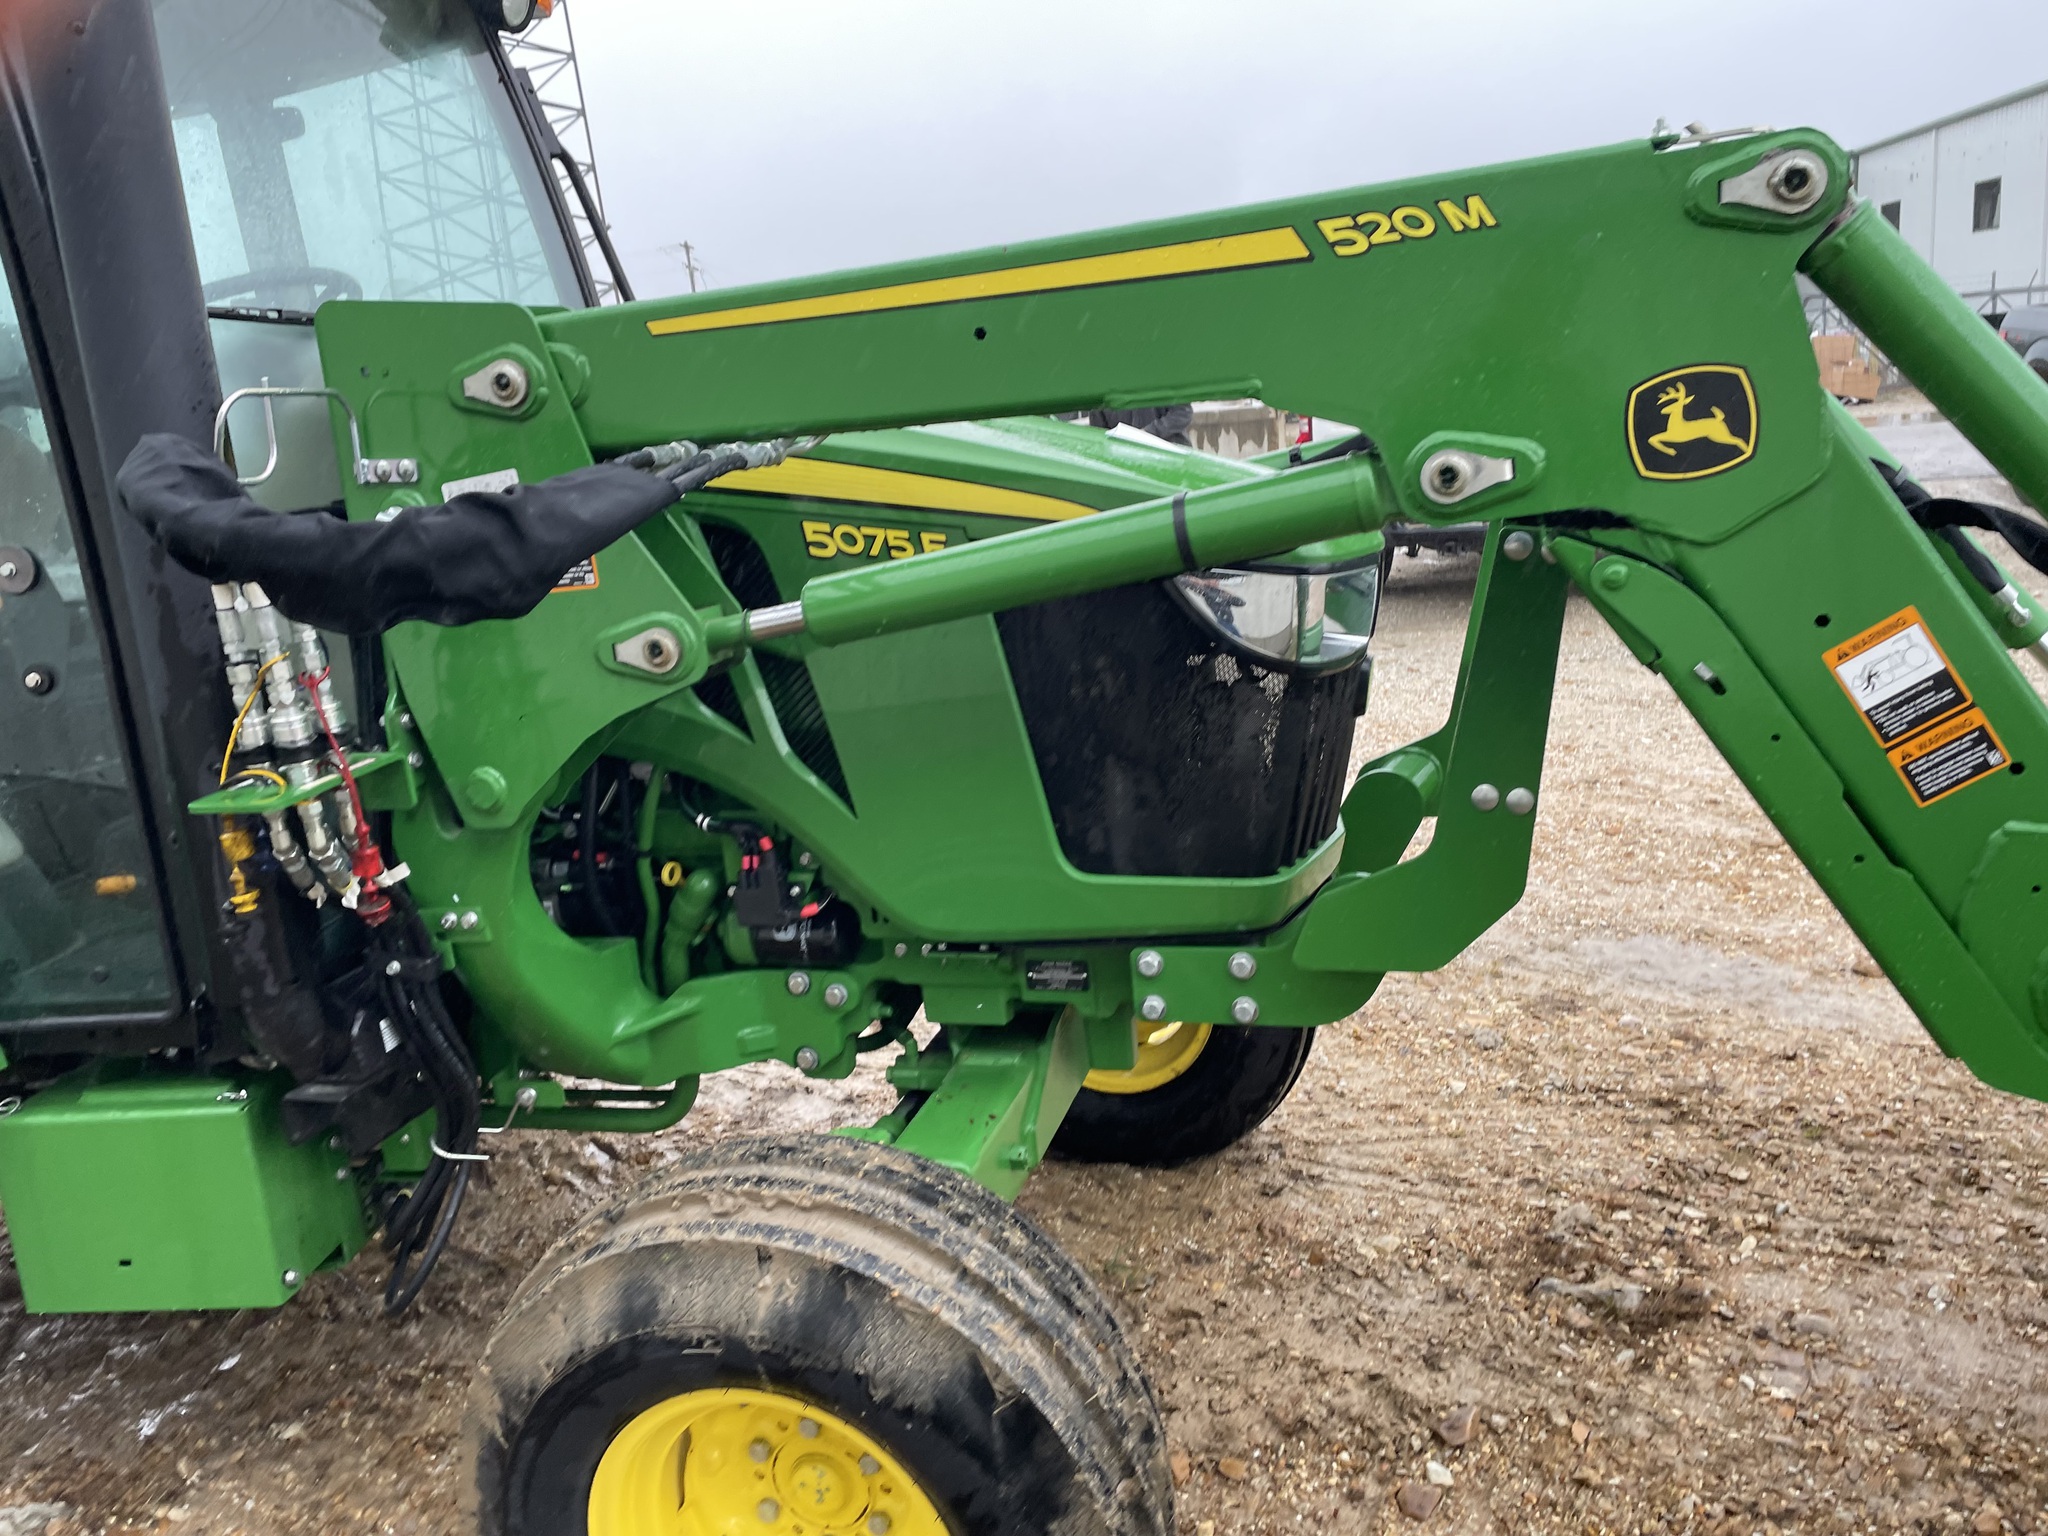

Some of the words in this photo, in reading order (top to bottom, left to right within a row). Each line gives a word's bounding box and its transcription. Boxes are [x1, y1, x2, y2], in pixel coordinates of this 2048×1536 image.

[1316, 205, 1436, 257] 520
[1436, 194, 1498, 232] M
[801, 520, 915, 559] 5075
